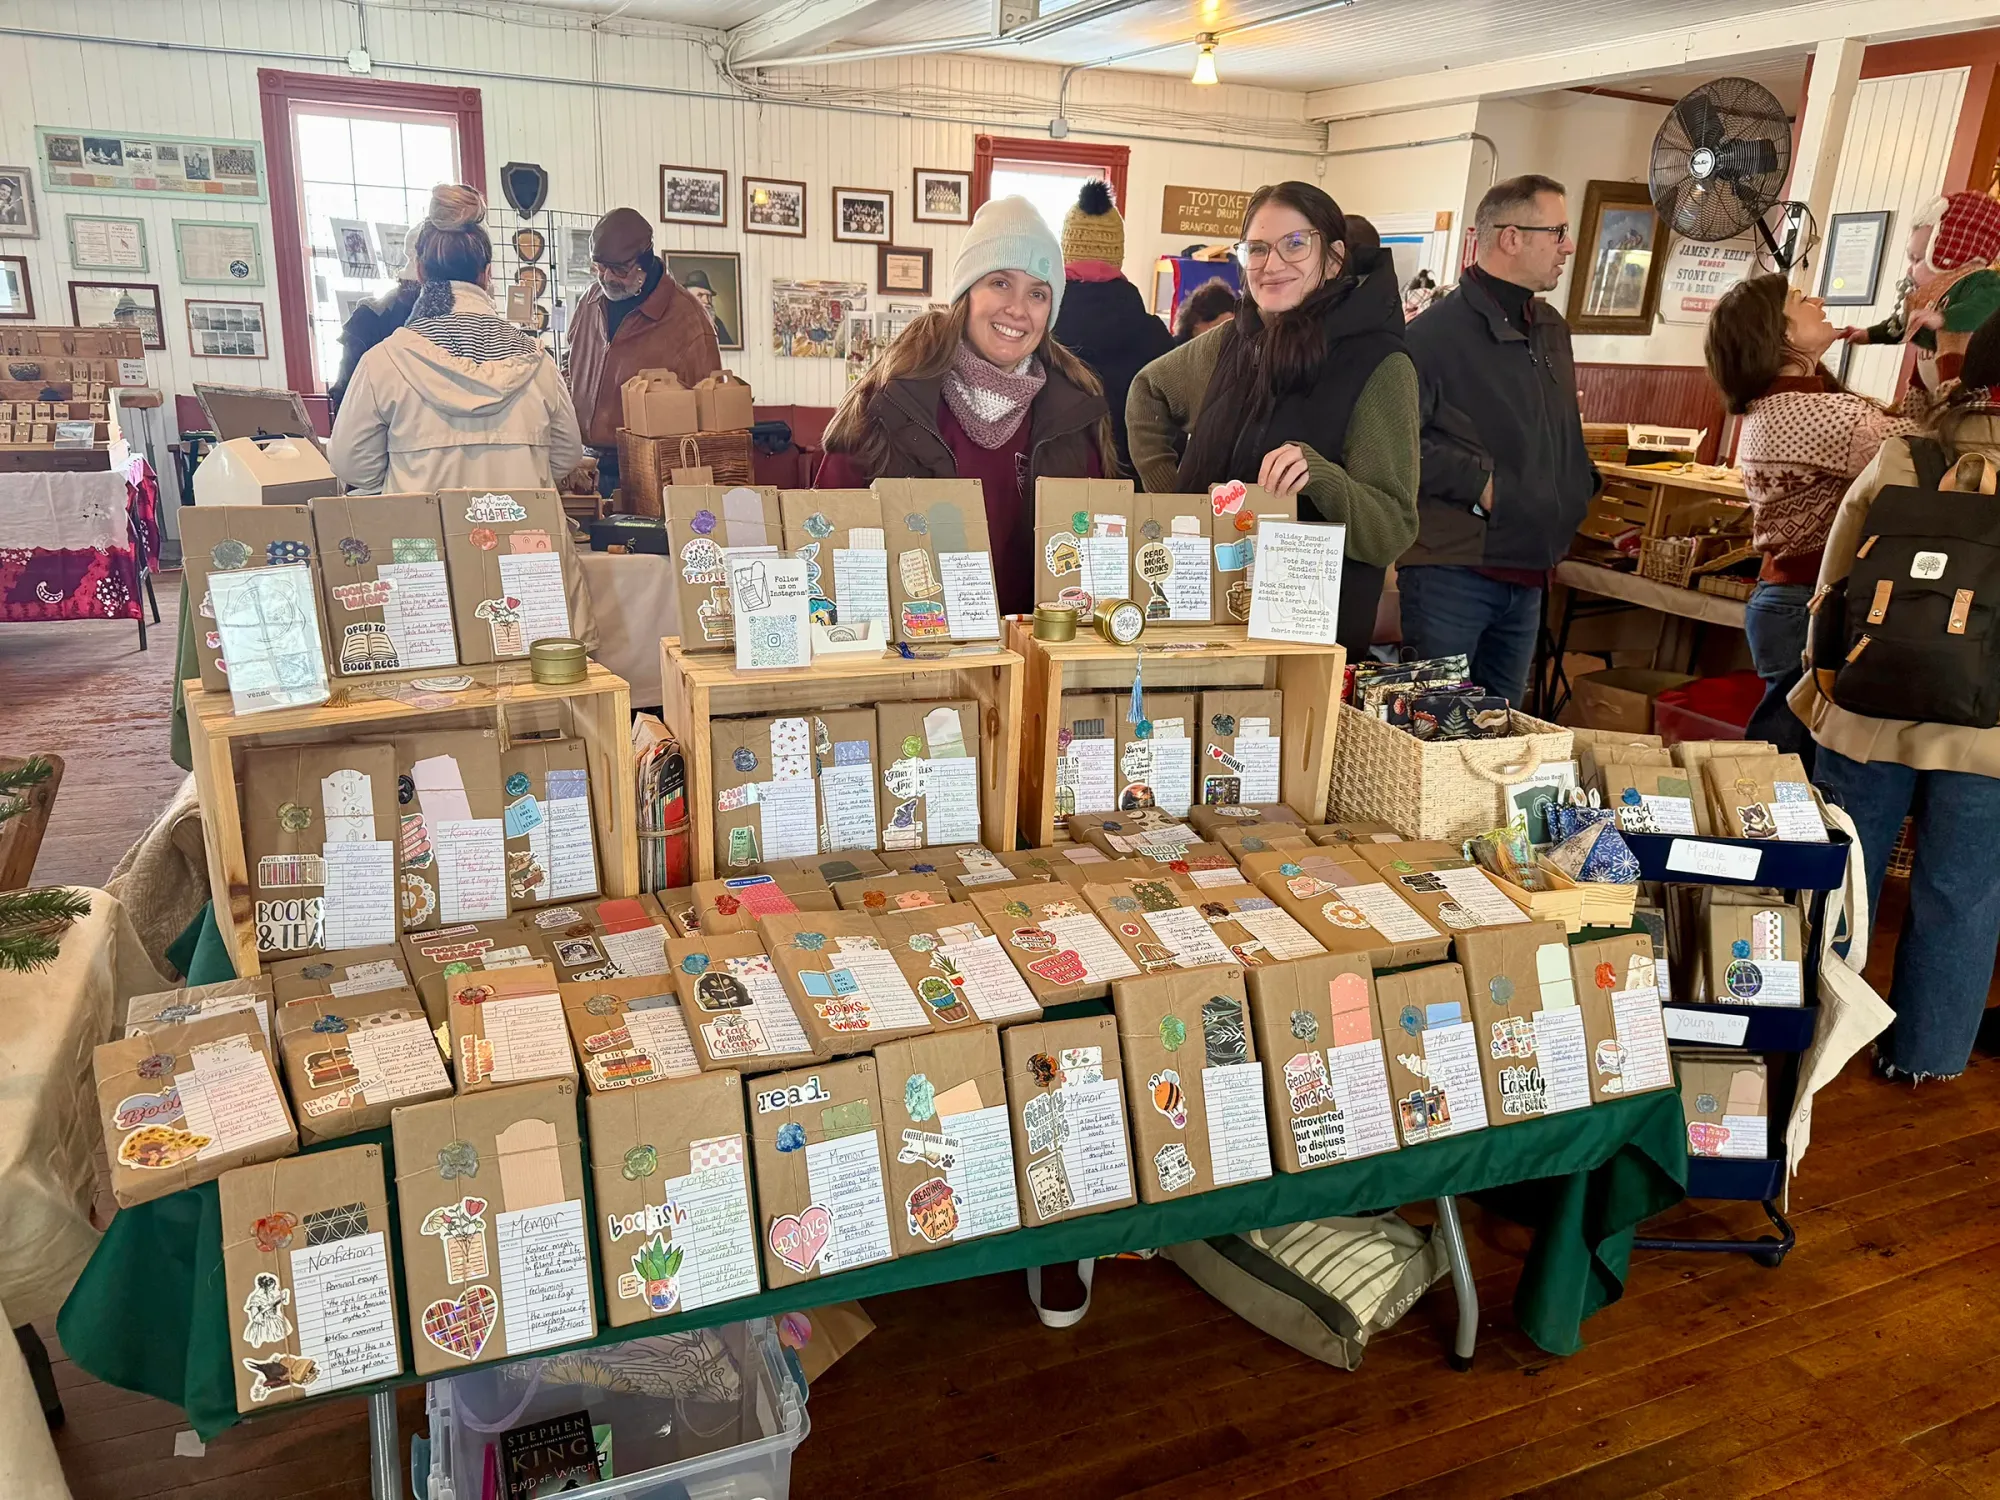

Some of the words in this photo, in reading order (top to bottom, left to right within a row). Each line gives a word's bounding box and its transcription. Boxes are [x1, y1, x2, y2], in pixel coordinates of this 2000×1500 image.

[1188, 191, 1251, 209] TOTOKET
[1179, 205, 1199, 216] FIFE
[1217, 208, 1239, 219] DRUM
[1180, 221, 1219, 234] BRANFORD,
[1679, 245, 1710, 257] JAMES
[1711, 248, 1719, 258] F.
[1722, 249, 1751, 261] KELLY
[1677, 269, 1705, 280] STONY
[1213, 484, 1246, 514] Books
[475, 508, 516, 521] CHAPTER
[1144, 549, 1163, 559] READ
[1276, 545, 1311, 554] paperback
[1144, 557, 1165, 567] MORE
[1144, 564, 1169, 575] BOOKS
[687, 573, 726, 584] PEOPLE
[334, 584, 372, 599] BOOKS
[345, 593, 389, 610] MAGIC
[1291, 607, 1329, 616] Bookmarks
[346, 624, 371, 634] OPEN
[372, 623, 386, 633] TO
[343, 661, 372, 673] BOOK
[374, 659, 400, 669] RECS
[247, 689, 270, 699] venmo
[1207, 745, 1212, 754] I
[1221, 754, 1246, 773] BOOKS
[1619, 804, 1651, 815] read
[523, 817, 541, 828] READING
[450, 823, 494, 838] Romance
[1686, 844, 1726, 860] Middle
[1696, 859, 1728, 875] Grade
[258, 899, 325, 923] BOOKS
[258, 925, 276, 949] &
[279, 923, 325, 949] TEA
[424, 943, 465, 955] BOOKS
[468, 940, 491, 949] ARE
[435, 949, 484, 961] MAGIC
[1034, 952, 1075, 970] emotional
[574, 961, 622, 980] read
[1044, 960, 1078, 977] support
[1056, 968, 1084, 982] kindle
[826, 1002, 864, 1016] BOOKS
[835, 1019, 868, 1030] WORLD
[1676, 1013, 1715, 1033] Young
[364, 1027, 416, 1042] Romance
[715, 1026, 751, 1037] Read
[1696, 1030, 1727, 1041] adult
[713, 1037, 764, 1049] Change
[193, 1063, 253, 1085] Romance
[857, 1064, 871, 1073] $12
[725, 1076, 737, 1086] $15
[1287, 1065, 1323, 1090] READING
[1500, 1068, 1547, 1096] Easily
[321, 1091, 340, 1102] MY
[557, 1084, 573, 1095] $15
[759, 1078, 829, 1111] read.
[1069, 1092, 1106, 1111] Memoir
[1292, 1084, 1333, 1113] smart
[310, 1104, 334, 1115] ERA
[1025, 1091, 1067, 1129] REALITY
[1503, 1101, 1520, 1113] Cats
[1525, 1099, 1548, 1112] Books
[1292, 1110, 1344, 1130] introverted
[1031, 1120, 1070, 1152] READING
[1296, 1131, 1310, 1141] but
[1312, 1124, 1344, 1137] willing
[945, 1138, 959, 1147] DOGS
[1298, 1144, 1307, 1154] to
[1309, 1136, 1346, 1151] discuss
[365, 1149, 379, 1158] $12
[829, 1149, 866, 1164] Memoir
[1308, 1150, 1338, 1163] books
[681, 1168, 735, 1187] nonfiction
[701, 1175, 738, 1190] essays
[913, 1180, 942, 1203] READING
[838, 1209, 862, 1220] moving
[511, 1212, 564, 1237] Memoir
[838, 1225, 857, 1234] Reads
[778, 1216, 829, 1255] BOOKS
[526, 1245, 548, 1254] Kosher
[843, 1242, 877, 1256] Thoughtful
[308, 1244, 374, 1273] Nonfiction
[841, 1257, 852, 1266] and
[856, 1249, 887, 1261] uplifting
[534, 1261, 554, 1271] Poland
[545, 1266, 574, 1275] America
[358, 1274, 378, 1284] essays
[378, 1287, 387, 1298] the
[528, 1282, 564, 1295] reclaiming
[542, 1288, 574, 1302] heritage
[324, 1308, 339, 1317] heart
[342, 1304, 349, 1314] of
[541, 1306, 577, 1317] importance
[579, 1300, 586, 1313] of
[352, 1321, 384, 1337] movement
[531, 1316, 565, 1332] preserving
[547, 1320, 584, 1334] traditions
[508, 1418, 584, 1447] STEPHEN
[512, 1438, 589, 1473] KING
[511, 1477, 536, 1494] END
[554, 1461, 595, 1479] WATCH
